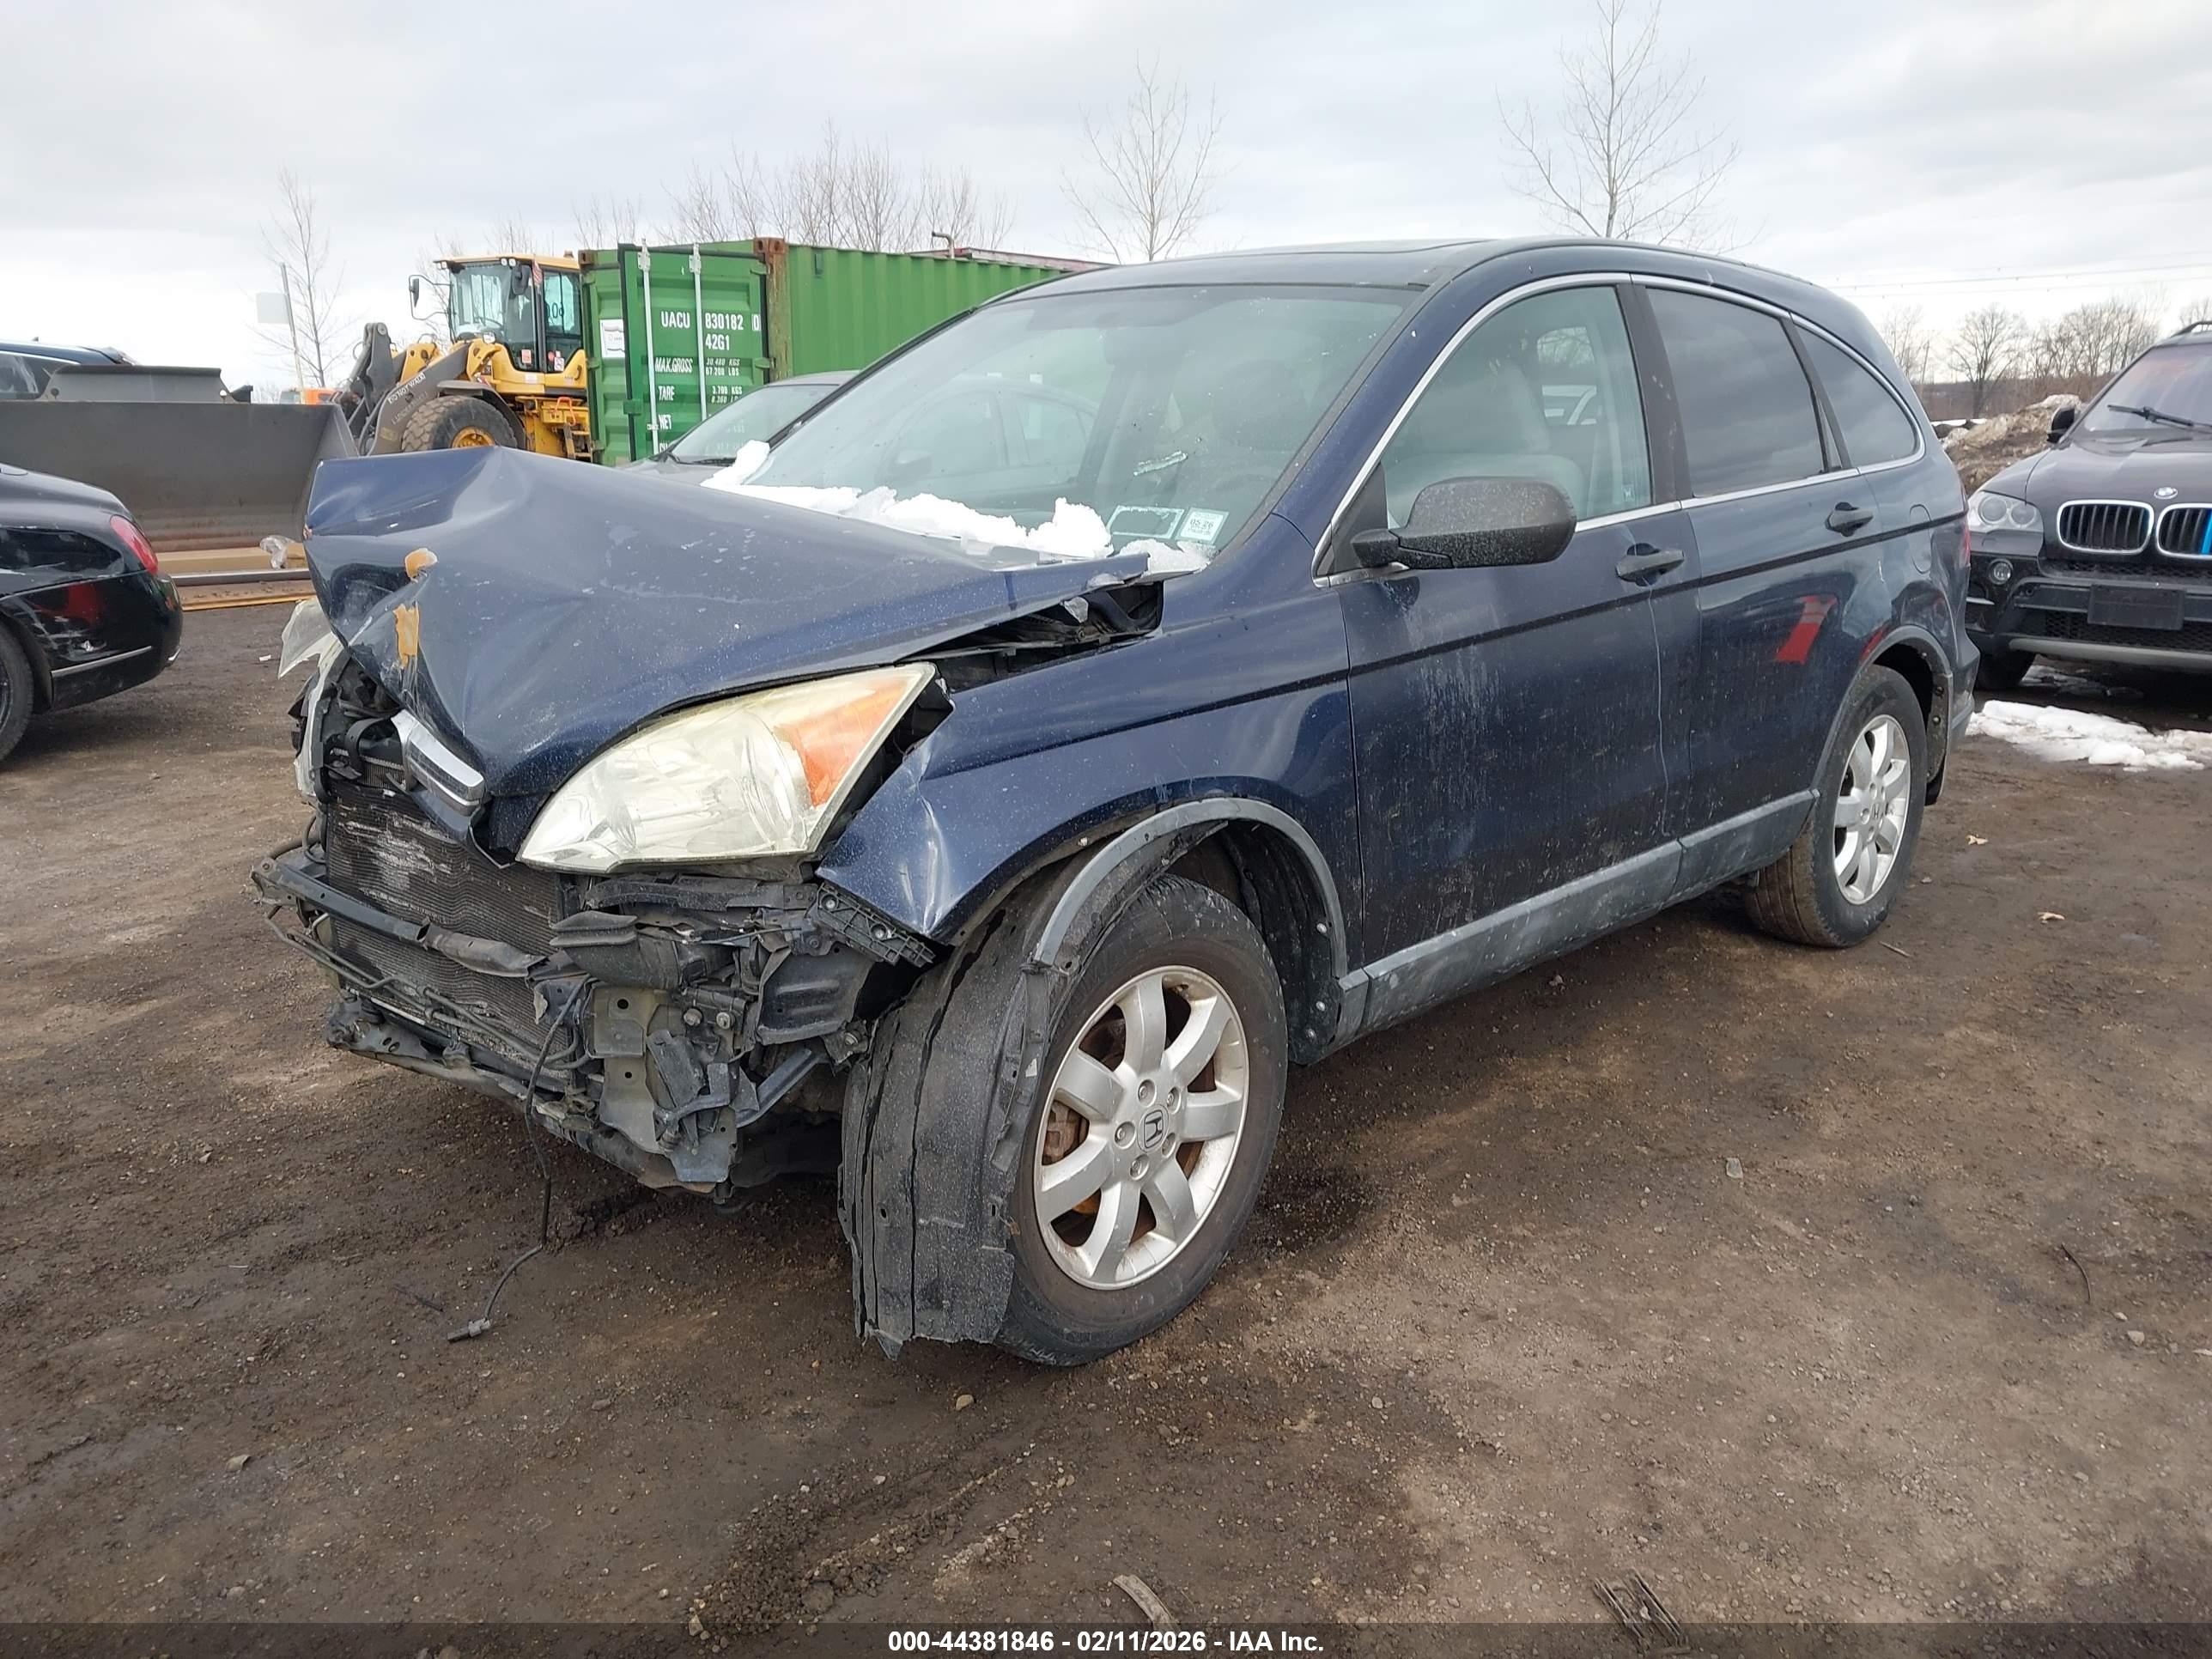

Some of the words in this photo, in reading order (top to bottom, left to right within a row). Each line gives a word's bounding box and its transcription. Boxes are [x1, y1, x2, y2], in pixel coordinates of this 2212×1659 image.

[660, 310, 691, 329] UACU
[704, 312, 744, 331] 830182
[705, 333, 730, 350] 42G1
[654, 356, 693, 374] MAX.GROSS
[658, 386, 675, 401] TARE
[731, 386, 742, 395] KGS
[659, 414, 672, 429] NET
